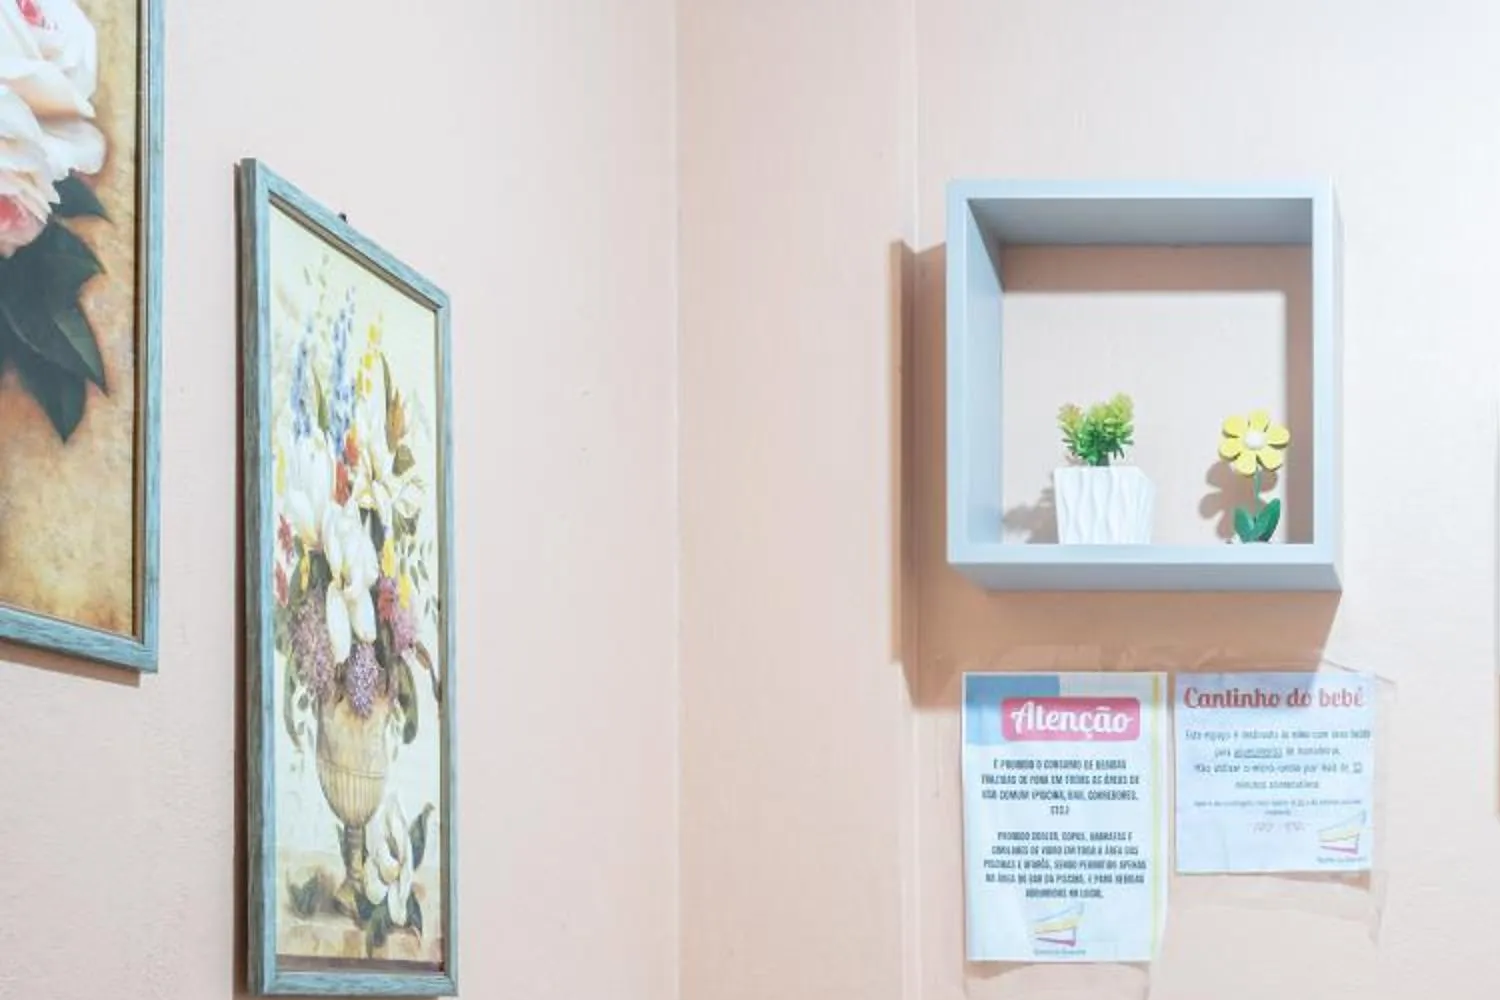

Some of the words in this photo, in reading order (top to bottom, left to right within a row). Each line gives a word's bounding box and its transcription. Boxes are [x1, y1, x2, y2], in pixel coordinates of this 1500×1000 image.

[1184, 687, 1281, 709] Cantinho
[1287, 688, 1312, 708] do
[1319, 686, 1365, 708] bebê
[1011, 701, 1133, 739] Atenção
